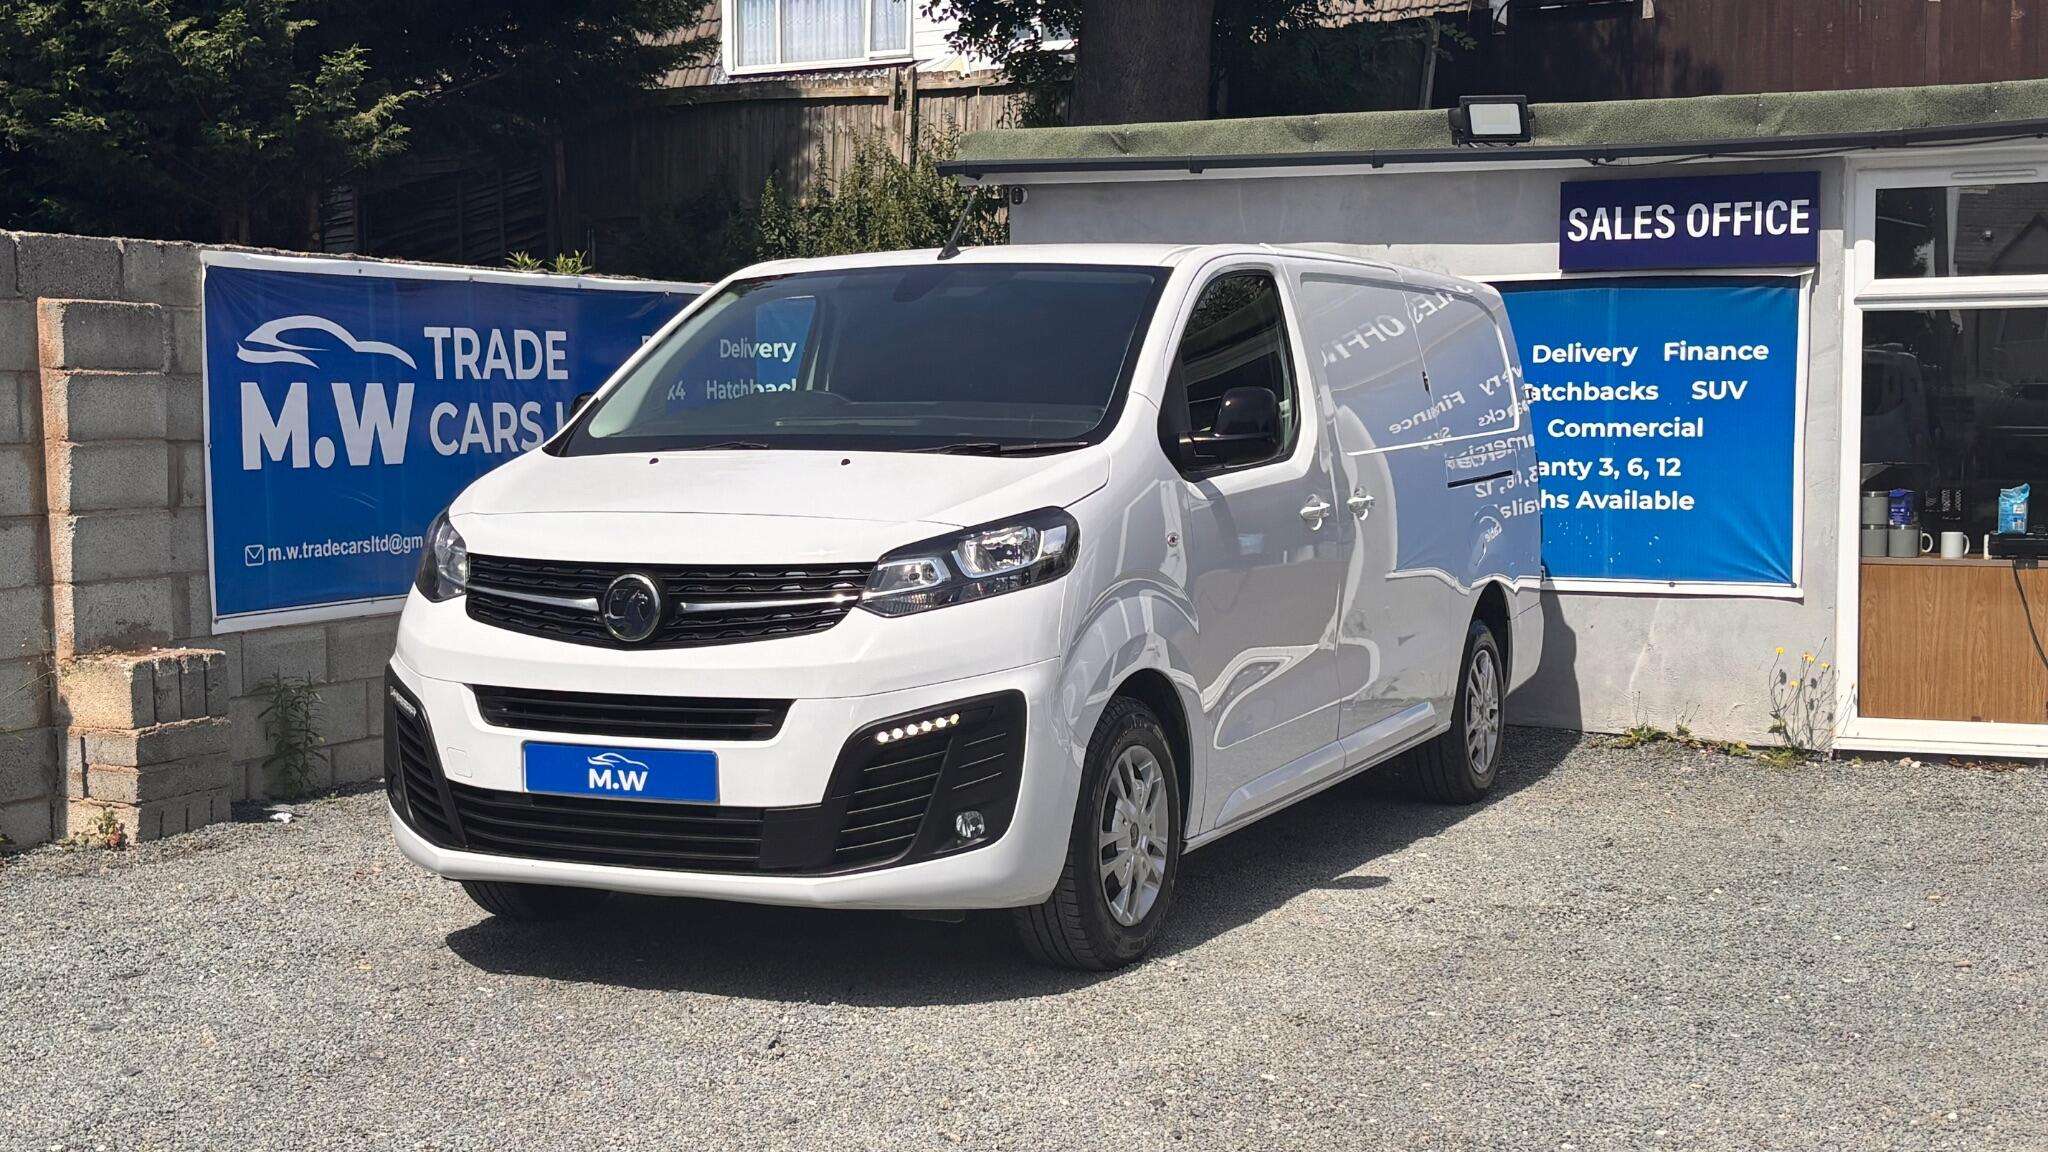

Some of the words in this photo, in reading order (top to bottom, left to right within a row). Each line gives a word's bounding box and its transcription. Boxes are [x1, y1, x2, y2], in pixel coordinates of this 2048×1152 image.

[1567, 205, 1676, 242] SALES
[1686, 199, 1810, 238] OFFICE
[423, 326, 569, 380] TRADE
[720, 337, 797, 362] Delivery
[1532, 343, 1638, 366] Delivery
[1664, 341, 1769, 361] Finance
[1528, 381, 1659, 401] atchbacks
[1691, 380, 1748, 400] SUV
[240, 382, 415, 470] M.W
[429, 401, 545, 456] CARS
[1547, 417, 1703, 438] Commercial
[1538, 458, 1592, 481] anty
[1598, 458, 1620, 480] 3,
[1627, 458, 1650, 480] 6,
[1656, 458, 1681, 477] 12
[1541, 490, 1569, 509] hs
[1576, 490, 1695, 511] Available
[267, 534, 423, 562] m.w.tradecarsltd@gm
[588, 768, 649, 792] M.W
